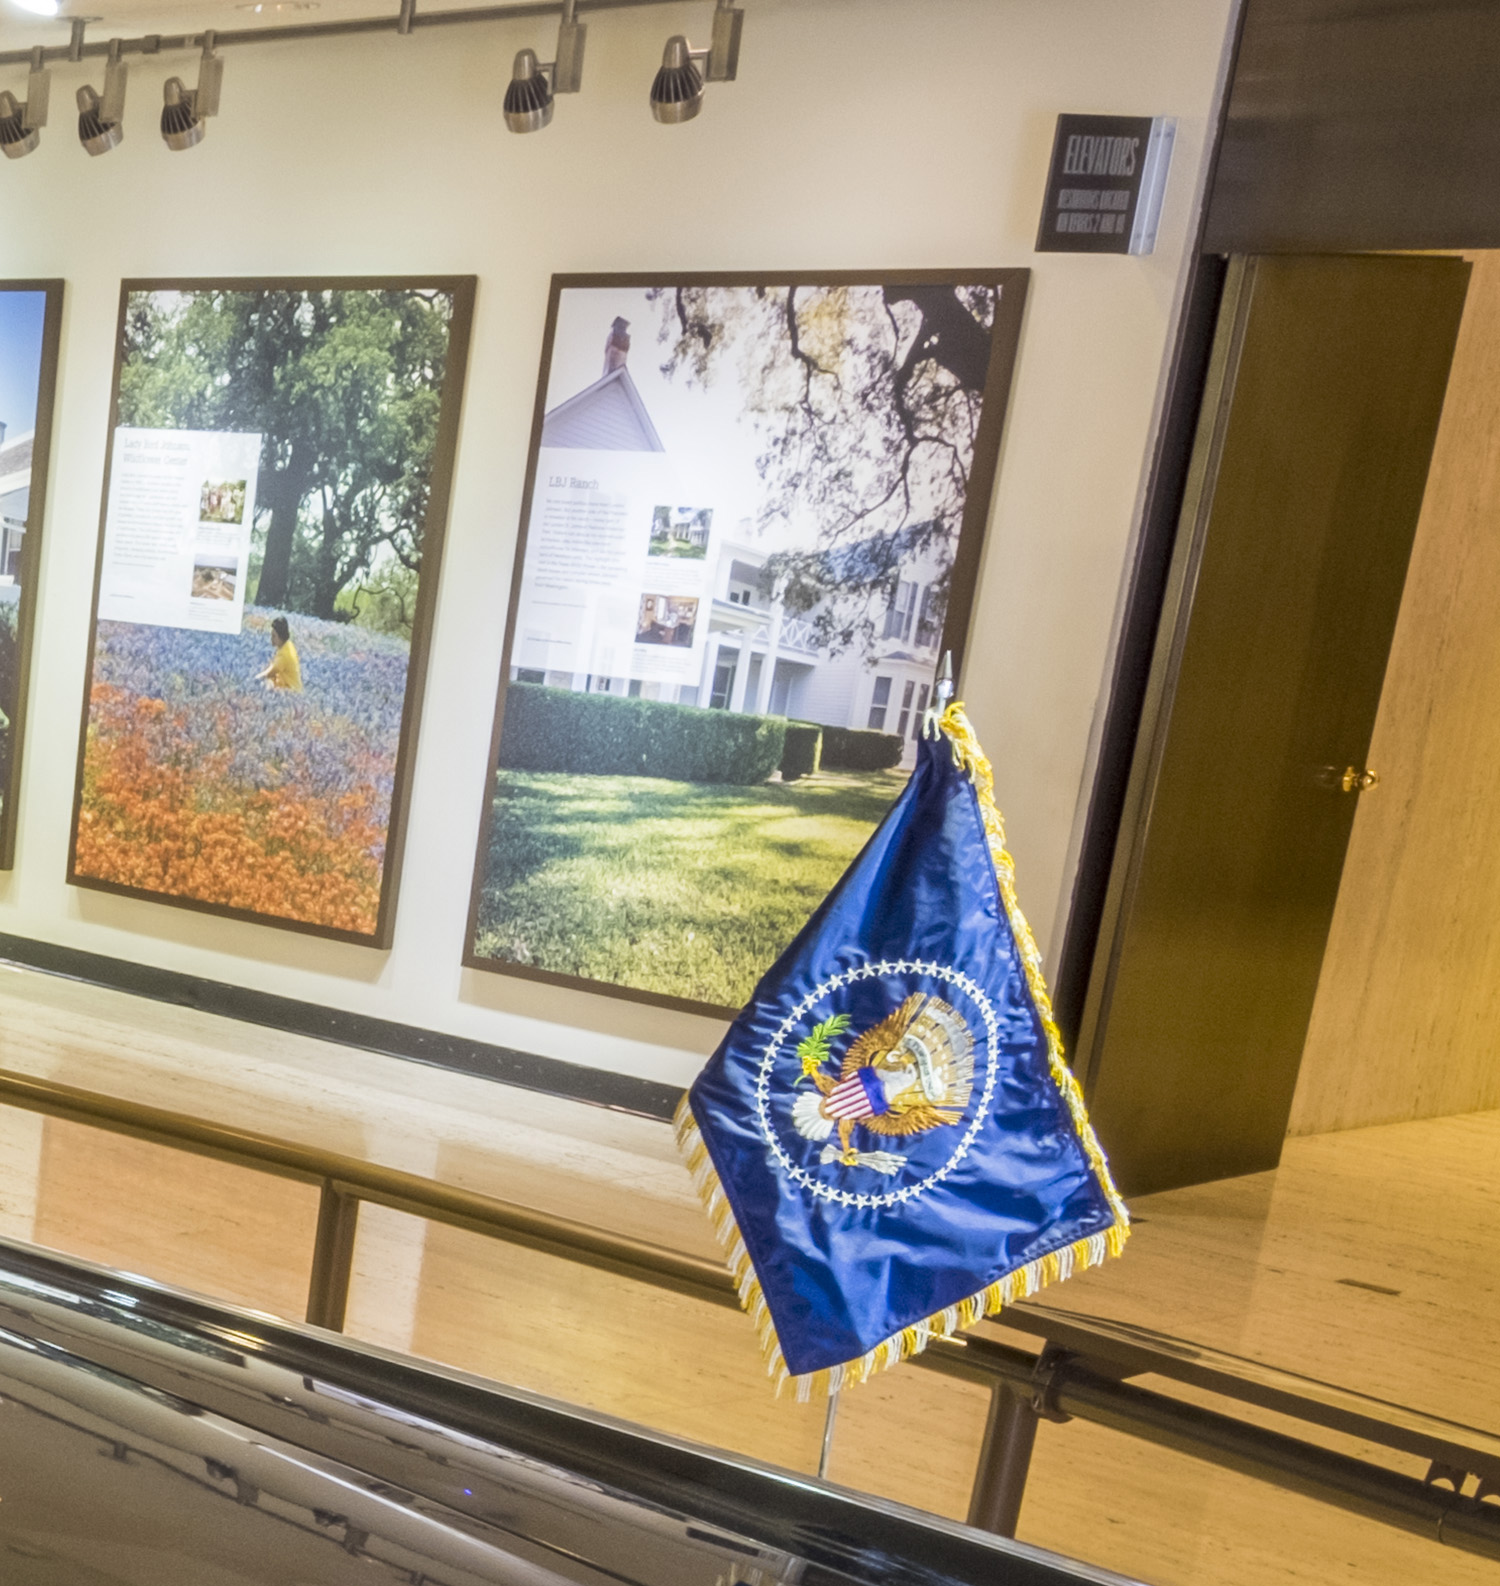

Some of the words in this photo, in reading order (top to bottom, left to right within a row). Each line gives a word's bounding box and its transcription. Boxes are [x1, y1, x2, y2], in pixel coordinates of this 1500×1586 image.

[1063, 134, 1140, 177] ELEVATORS
[548, 476, 568, 488] LBJ
[569, 477, 600, 490] Ranch
